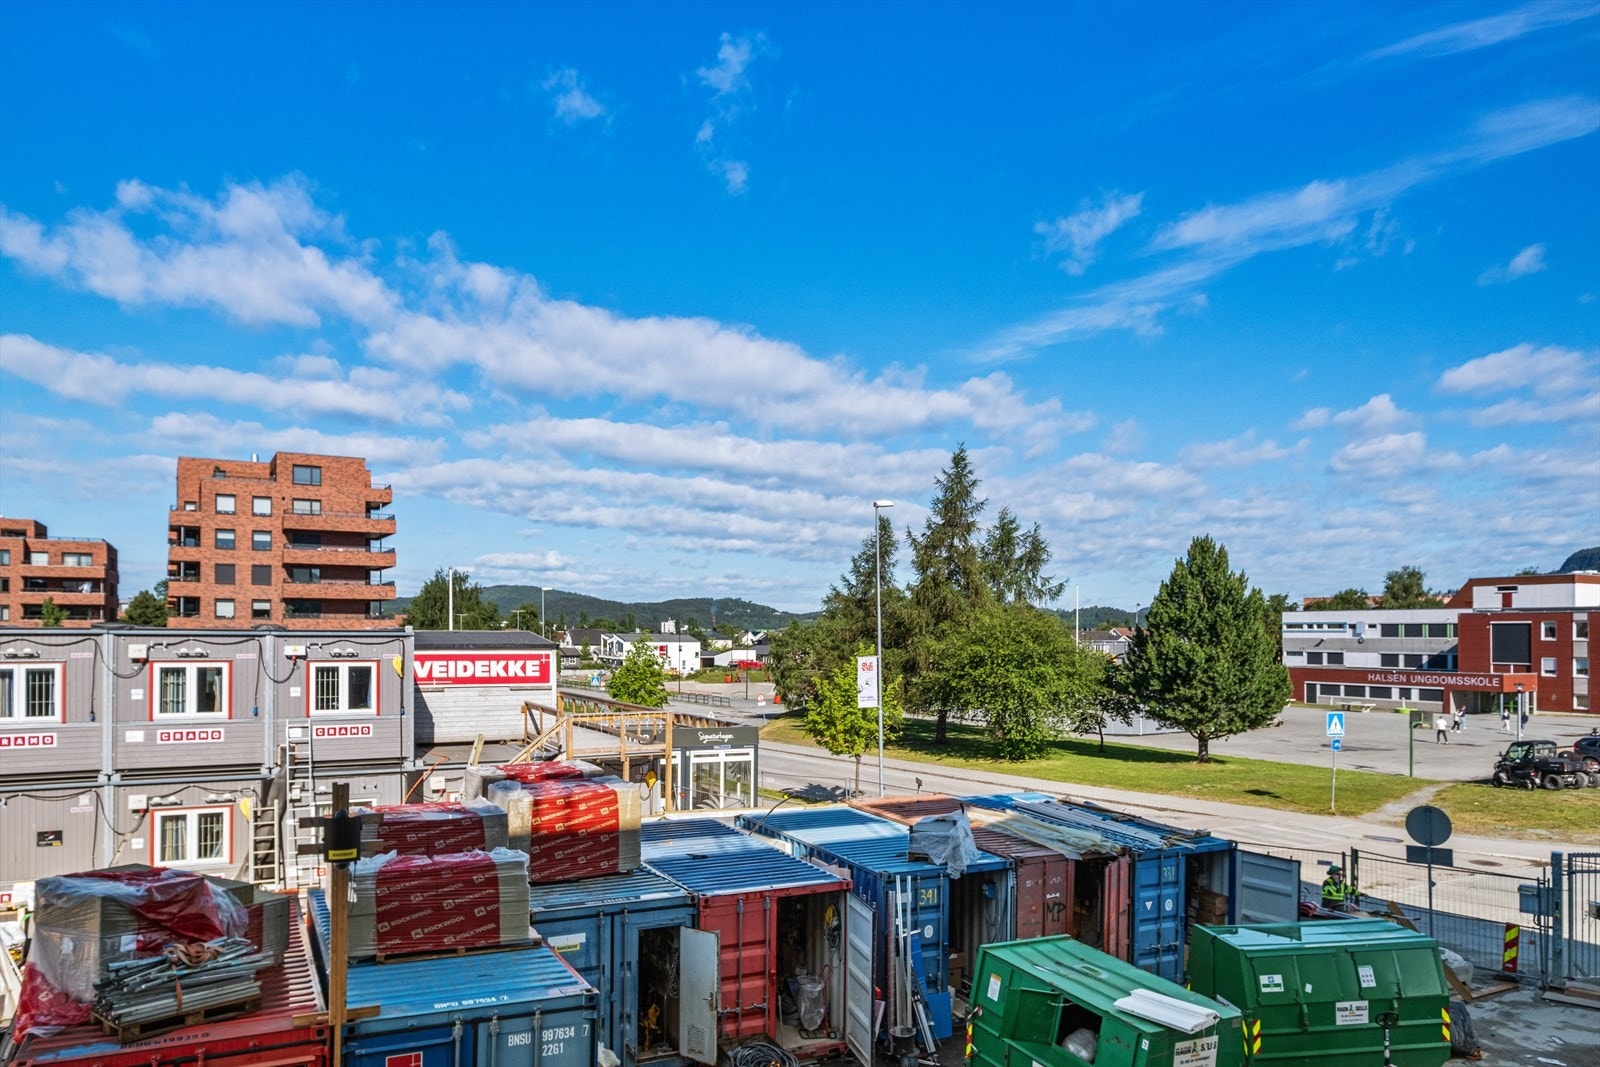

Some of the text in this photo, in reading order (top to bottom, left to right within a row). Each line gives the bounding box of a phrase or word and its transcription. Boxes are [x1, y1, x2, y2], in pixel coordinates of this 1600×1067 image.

[414, 660, 540, 678] VEIDEKKE
[1367, 673, 1500, 687] HALSEN UNGDOMSSKOLE
[160, 731, 221, 741] CRAMO
[316, 726, 370, 736] CRAMO
[564, 814, 594, 827] ROCKWOOL
[587, 819, 616, 832] ROCKWOOL
[919, 888, 937, 905] 341
[390, 908, 433, 927] ROCKWOOL
[424, 916, 465, 934] ROCKWOOL
[455, 923, 496, 941] ROCKWOOL
[508, 1033, 532, 1047] BNSU
[542, 1026, 575, 1042] 997634
[541, 1044, 564, 1057] 22G1
